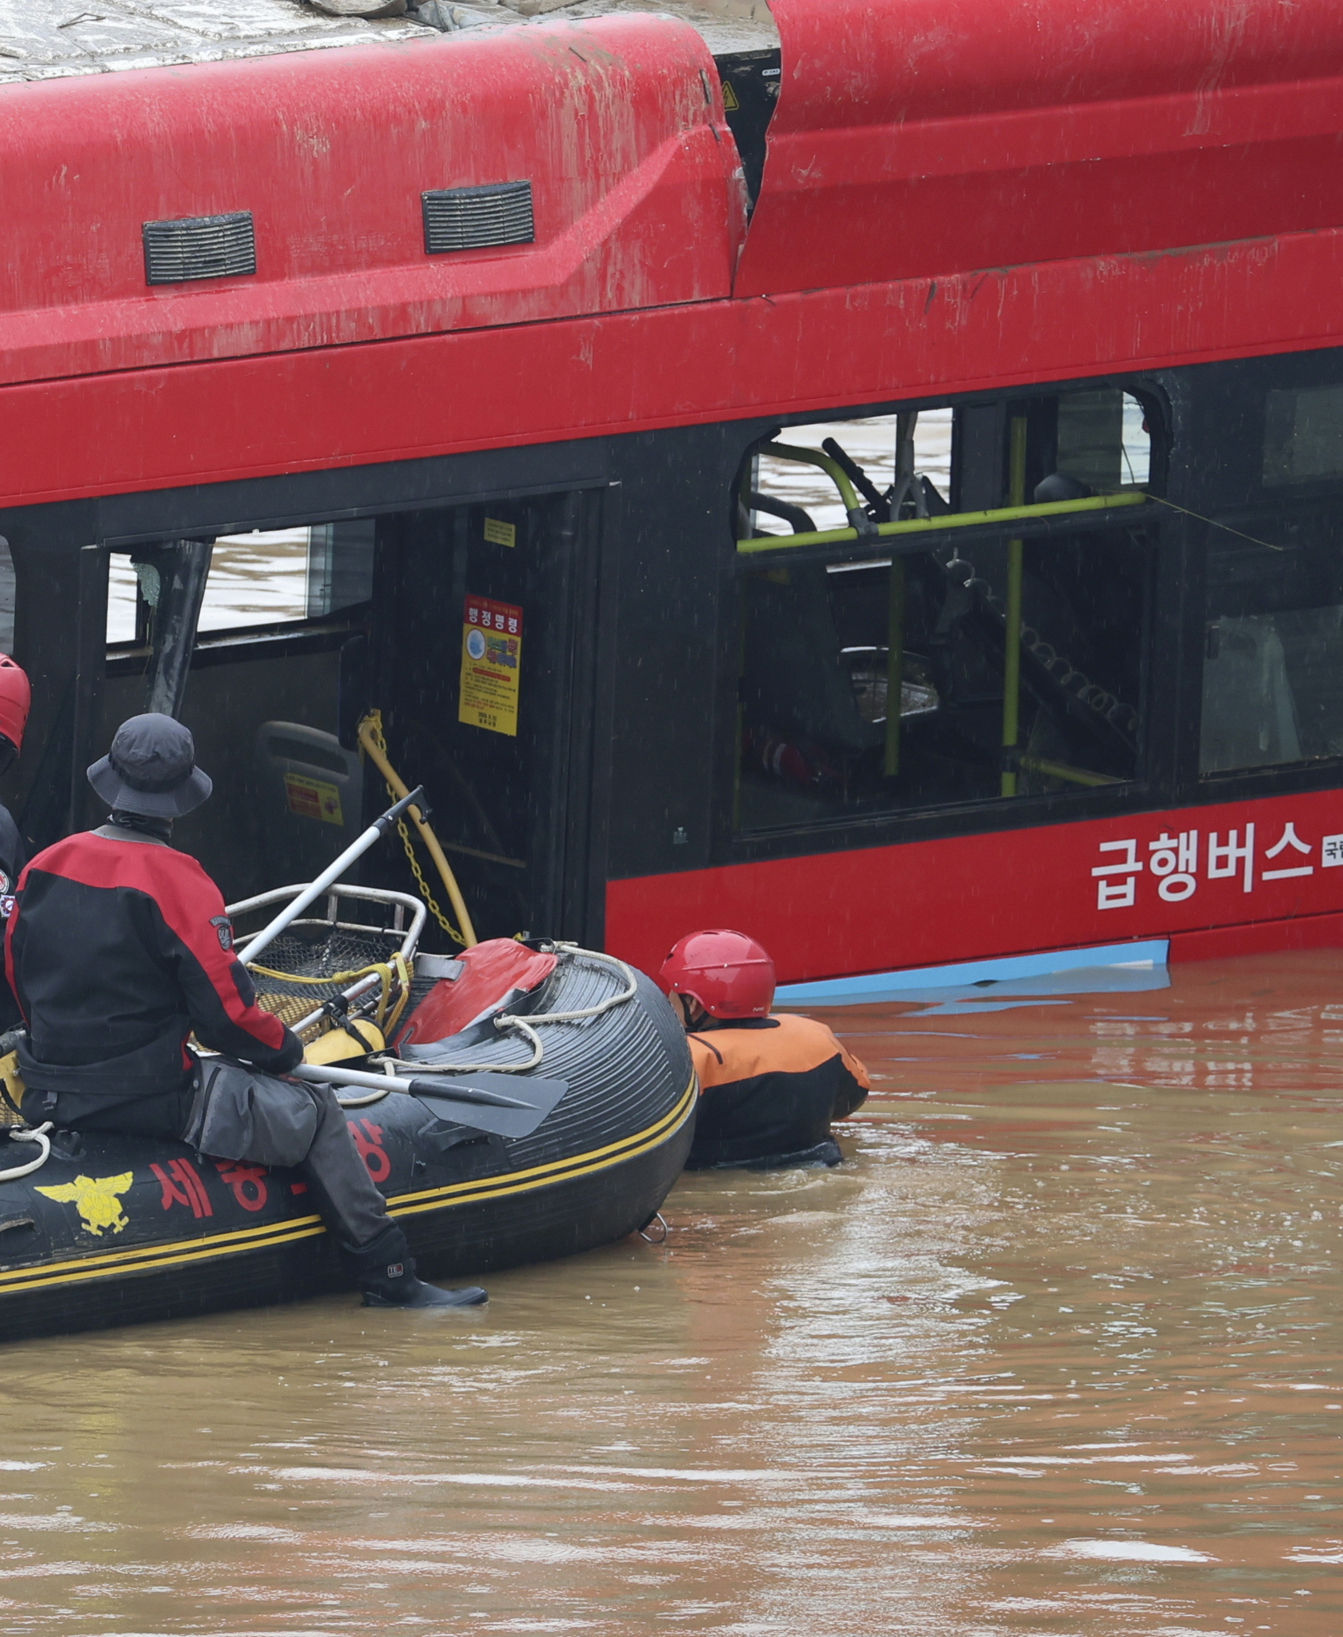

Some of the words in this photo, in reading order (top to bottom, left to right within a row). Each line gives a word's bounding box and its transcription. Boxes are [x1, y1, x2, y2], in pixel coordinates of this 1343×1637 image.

[468, 607, 518, 633] 행정명령
[1325, 840, 1343, 860] 국
[1091, 822, 1314, 910] 급행버스
